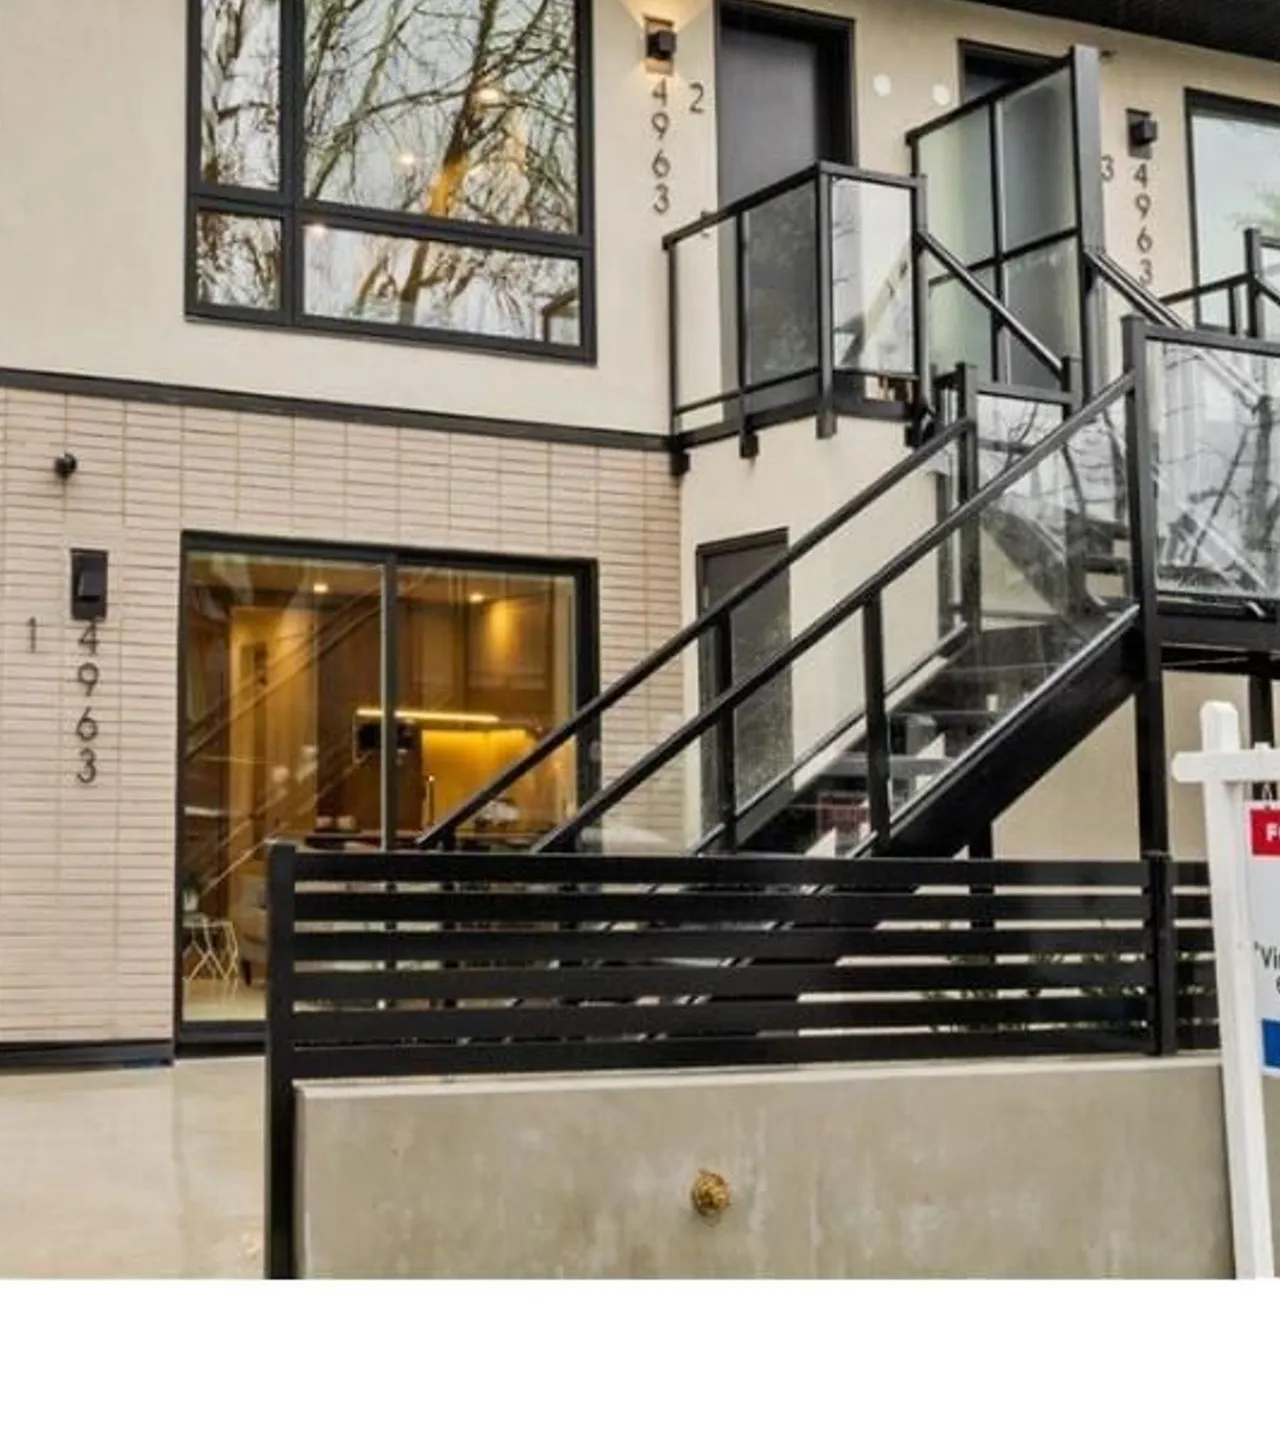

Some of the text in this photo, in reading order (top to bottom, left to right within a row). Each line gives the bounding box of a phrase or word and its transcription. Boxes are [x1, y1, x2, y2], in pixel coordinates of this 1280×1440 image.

[689, 81, 704, 114] 2
[651, 78, 670, 214] 4963
[1100, 154, 1115, 182] 3
[1133, 163, 1153, 288] 4963
[26, 616, 38, 654] 1
[76, 620, 100, 784] 4963
